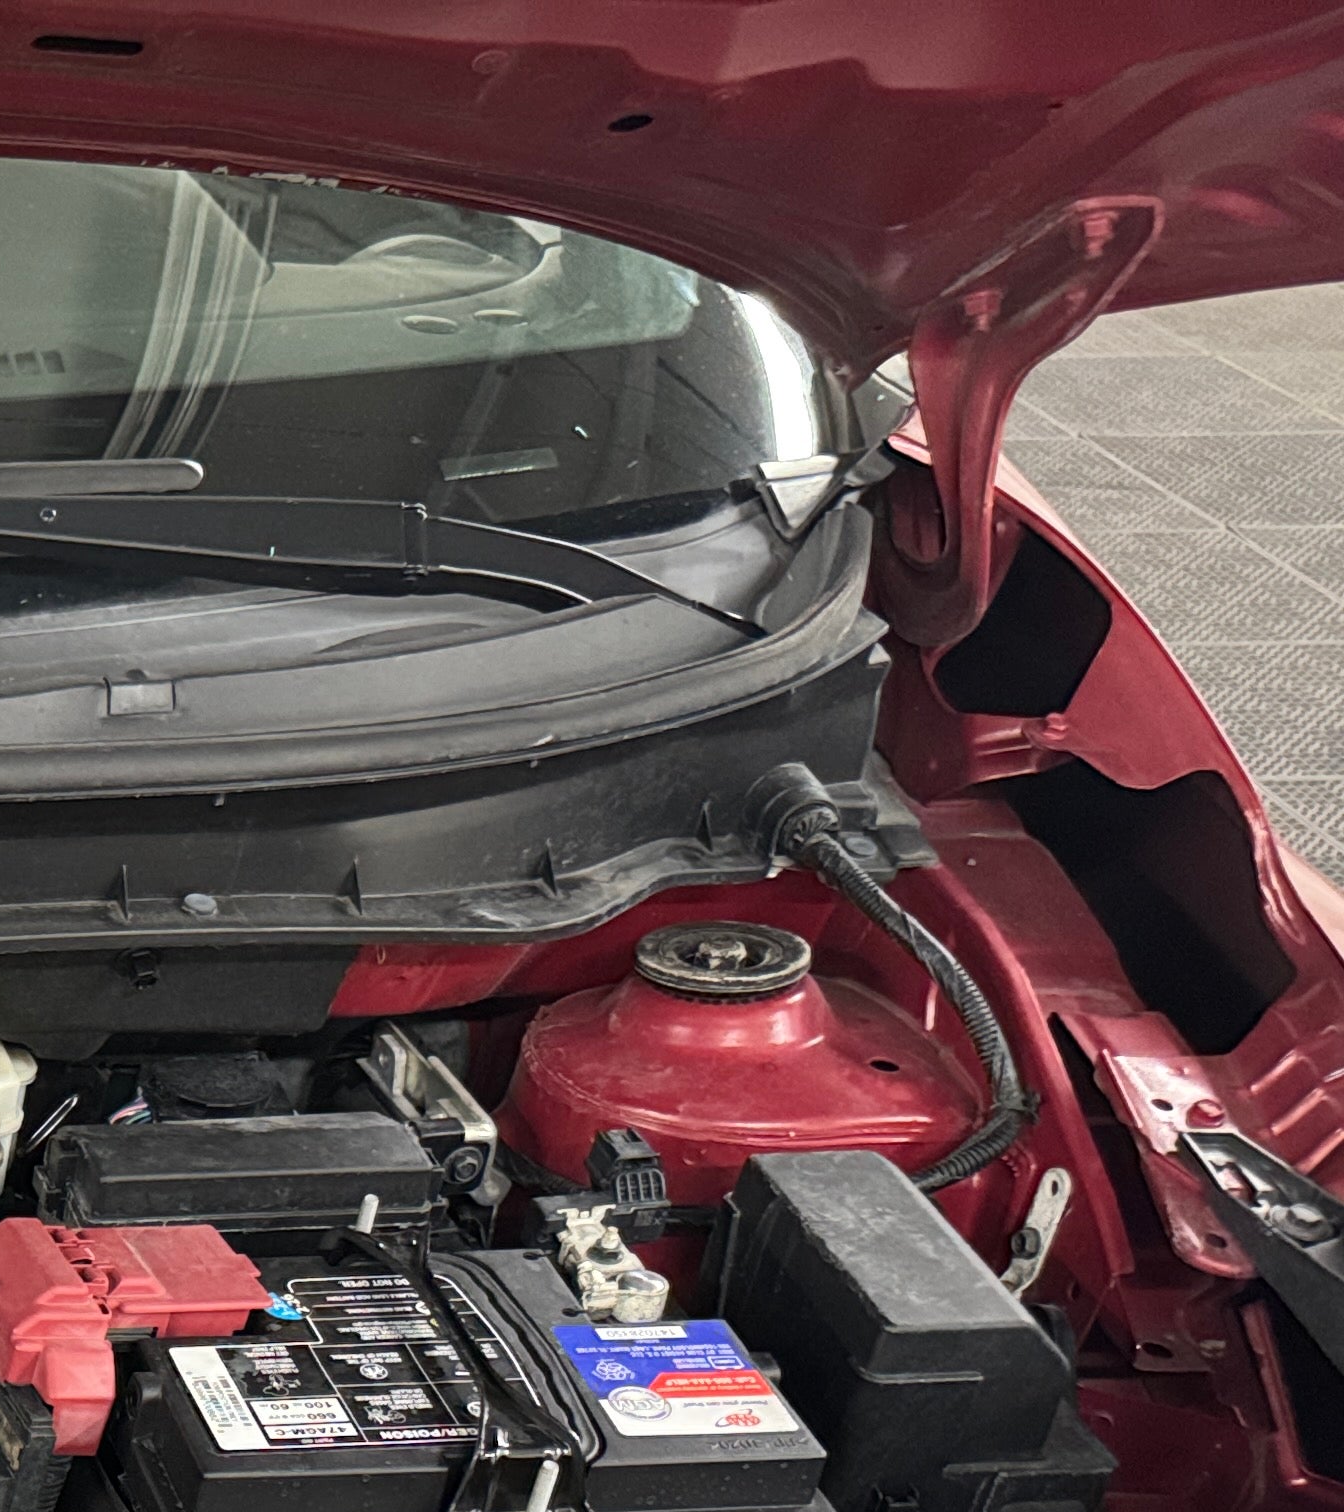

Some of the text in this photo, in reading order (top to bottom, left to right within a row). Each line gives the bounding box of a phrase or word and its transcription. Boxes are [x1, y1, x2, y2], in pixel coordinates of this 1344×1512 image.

[372, 1279, 393, 1287] NOT
[394, 1278, 410, 1286] DO
[270, 1403, 289, 1411] 60
[304, 1401, 333, 1409] 100
[611, 1398, 665, 1411] AGM
[307, 1412, 336, 1420] 660
[274, 1427, 347, 1436] 47AGM-C
